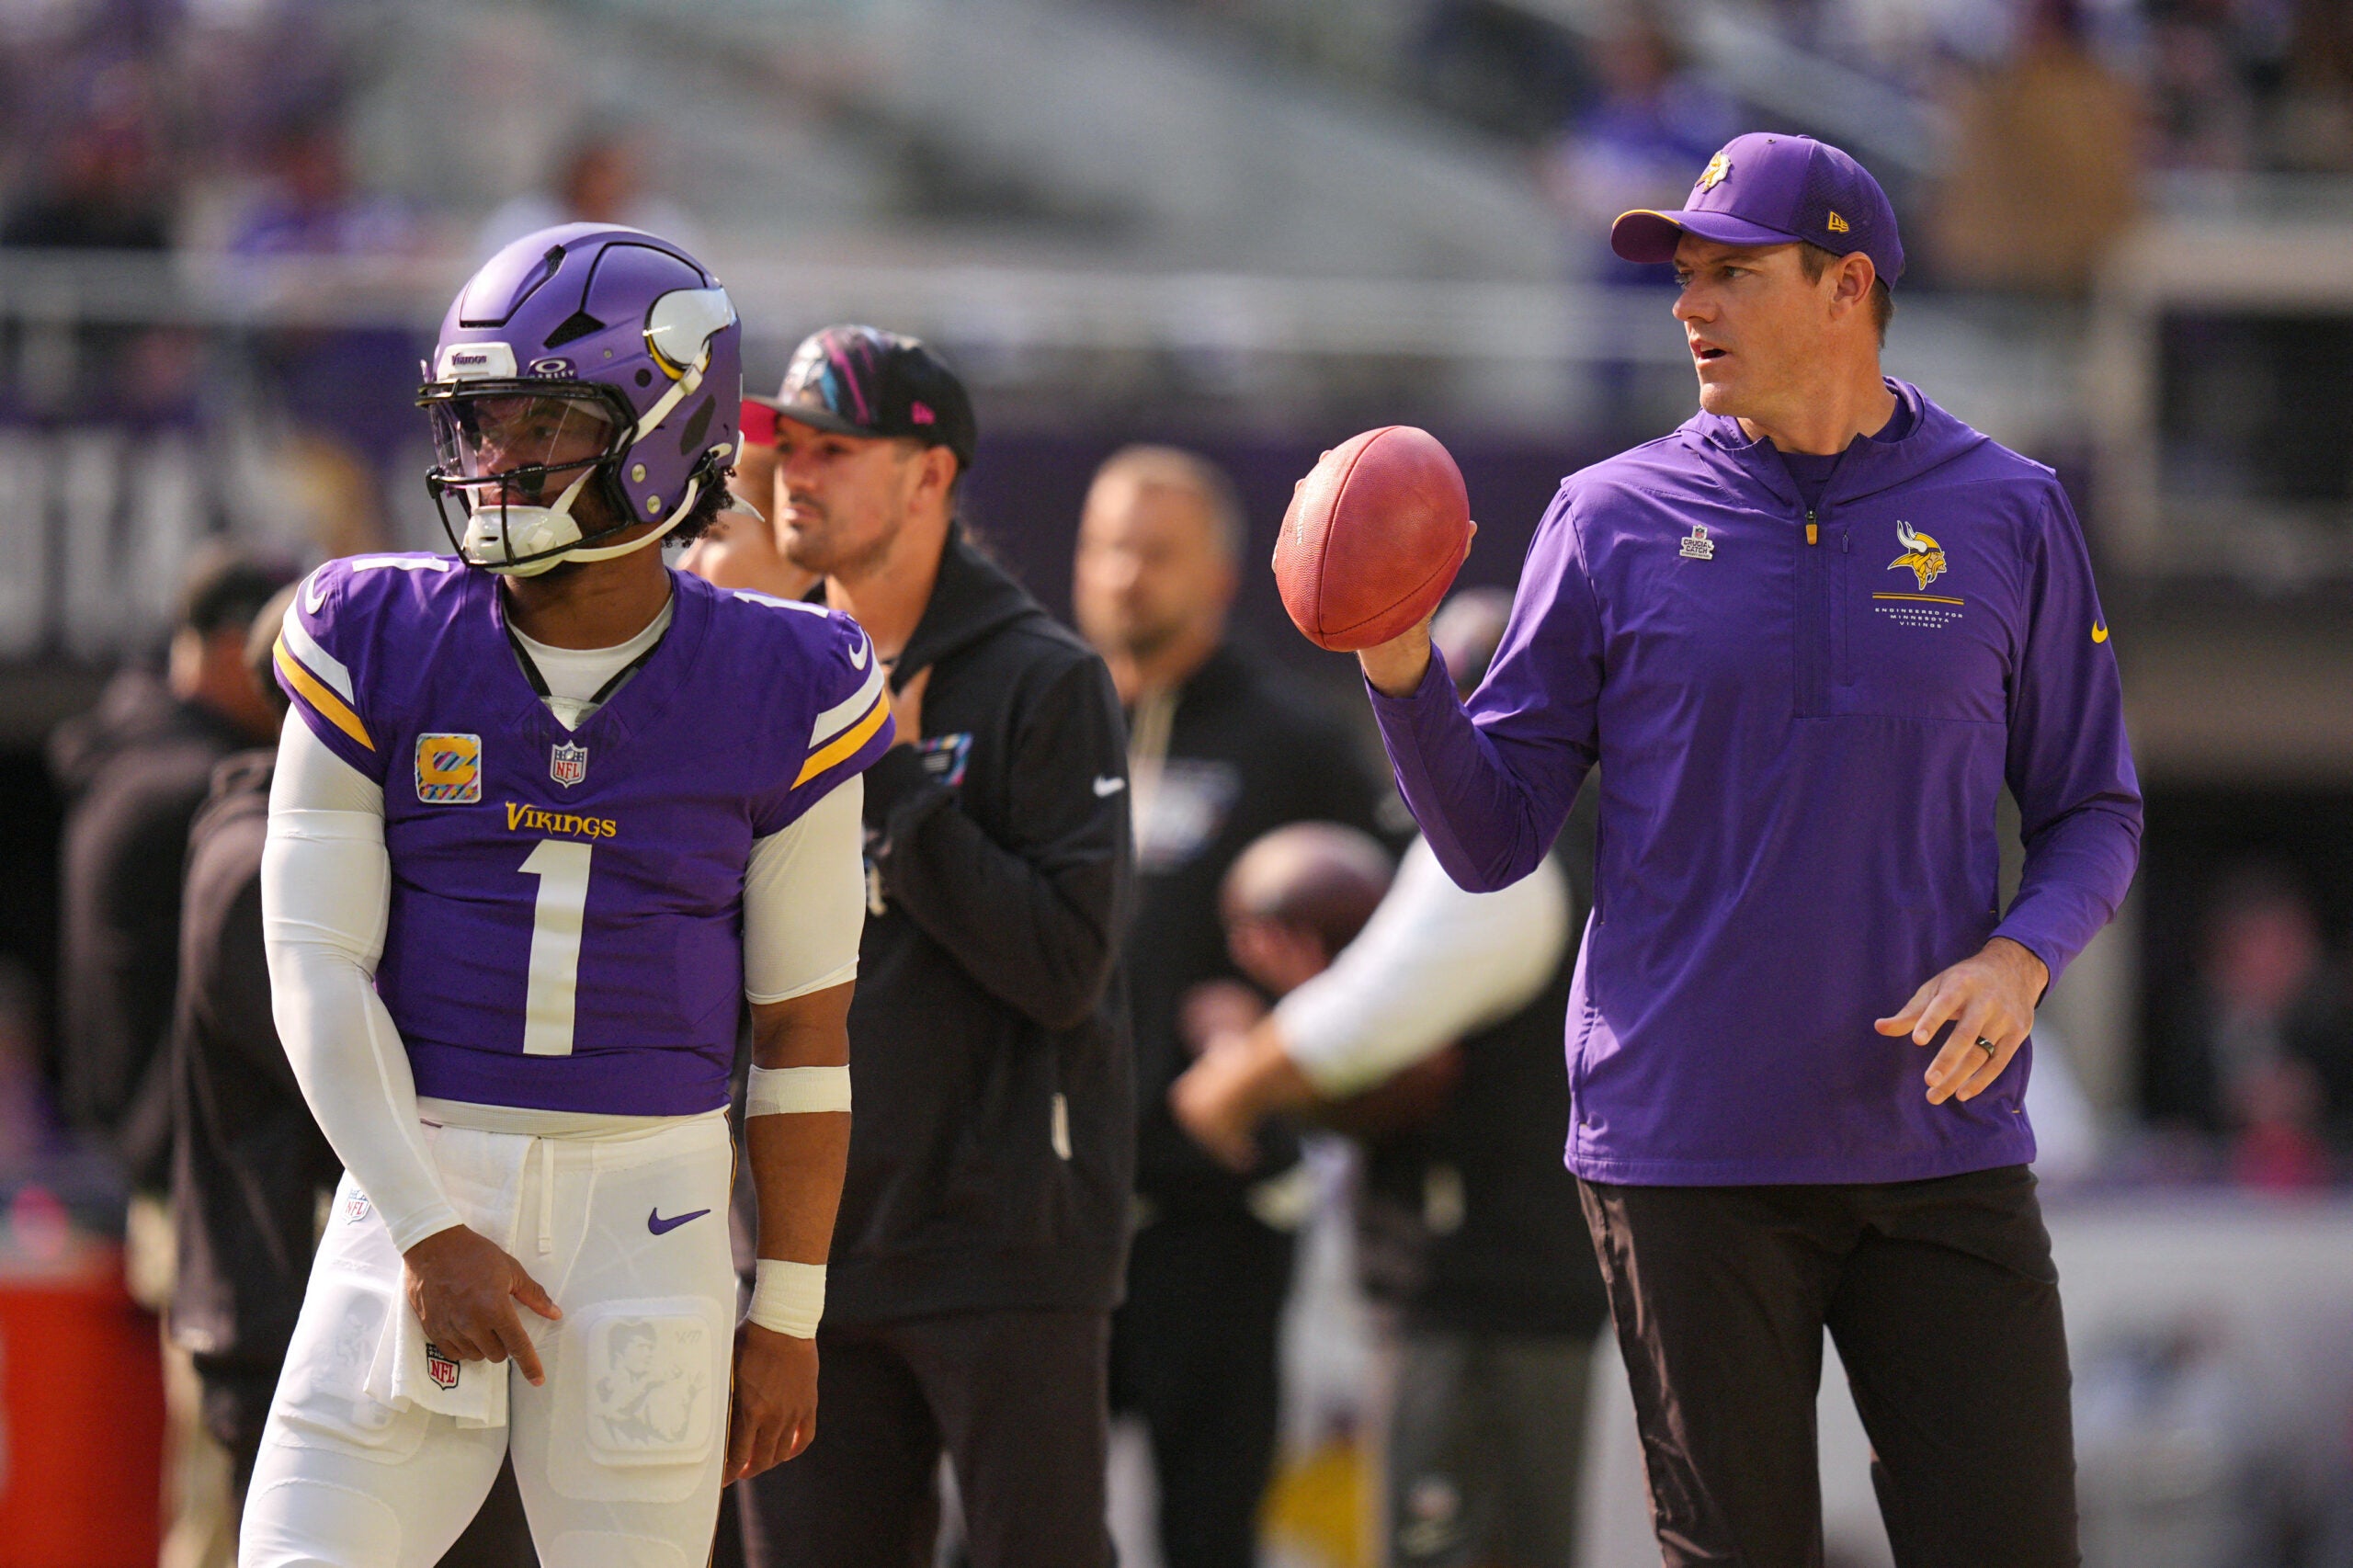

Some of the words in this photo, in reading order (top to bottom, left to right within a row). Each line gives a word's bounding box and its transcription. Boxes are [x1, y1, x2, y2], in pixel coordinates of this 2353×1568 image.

[1683, 539, 1711, 549] CRUCIAL
[1686, 546, 1708, 554] CATCH
[1875, 608, 1939, 616] ENGINEERED
[1890, 614, 1949, 623] MINNESOTA
[1899, 620, 1942, 629] VIKINGS
[418, 737, 478, 785] C
[556, 762, 581, 779] NFL
[517, 838, 593, 1055] 1
[346, 1201, 365, 1216] NFL
[430, 1359, 456, 1384] NFL
